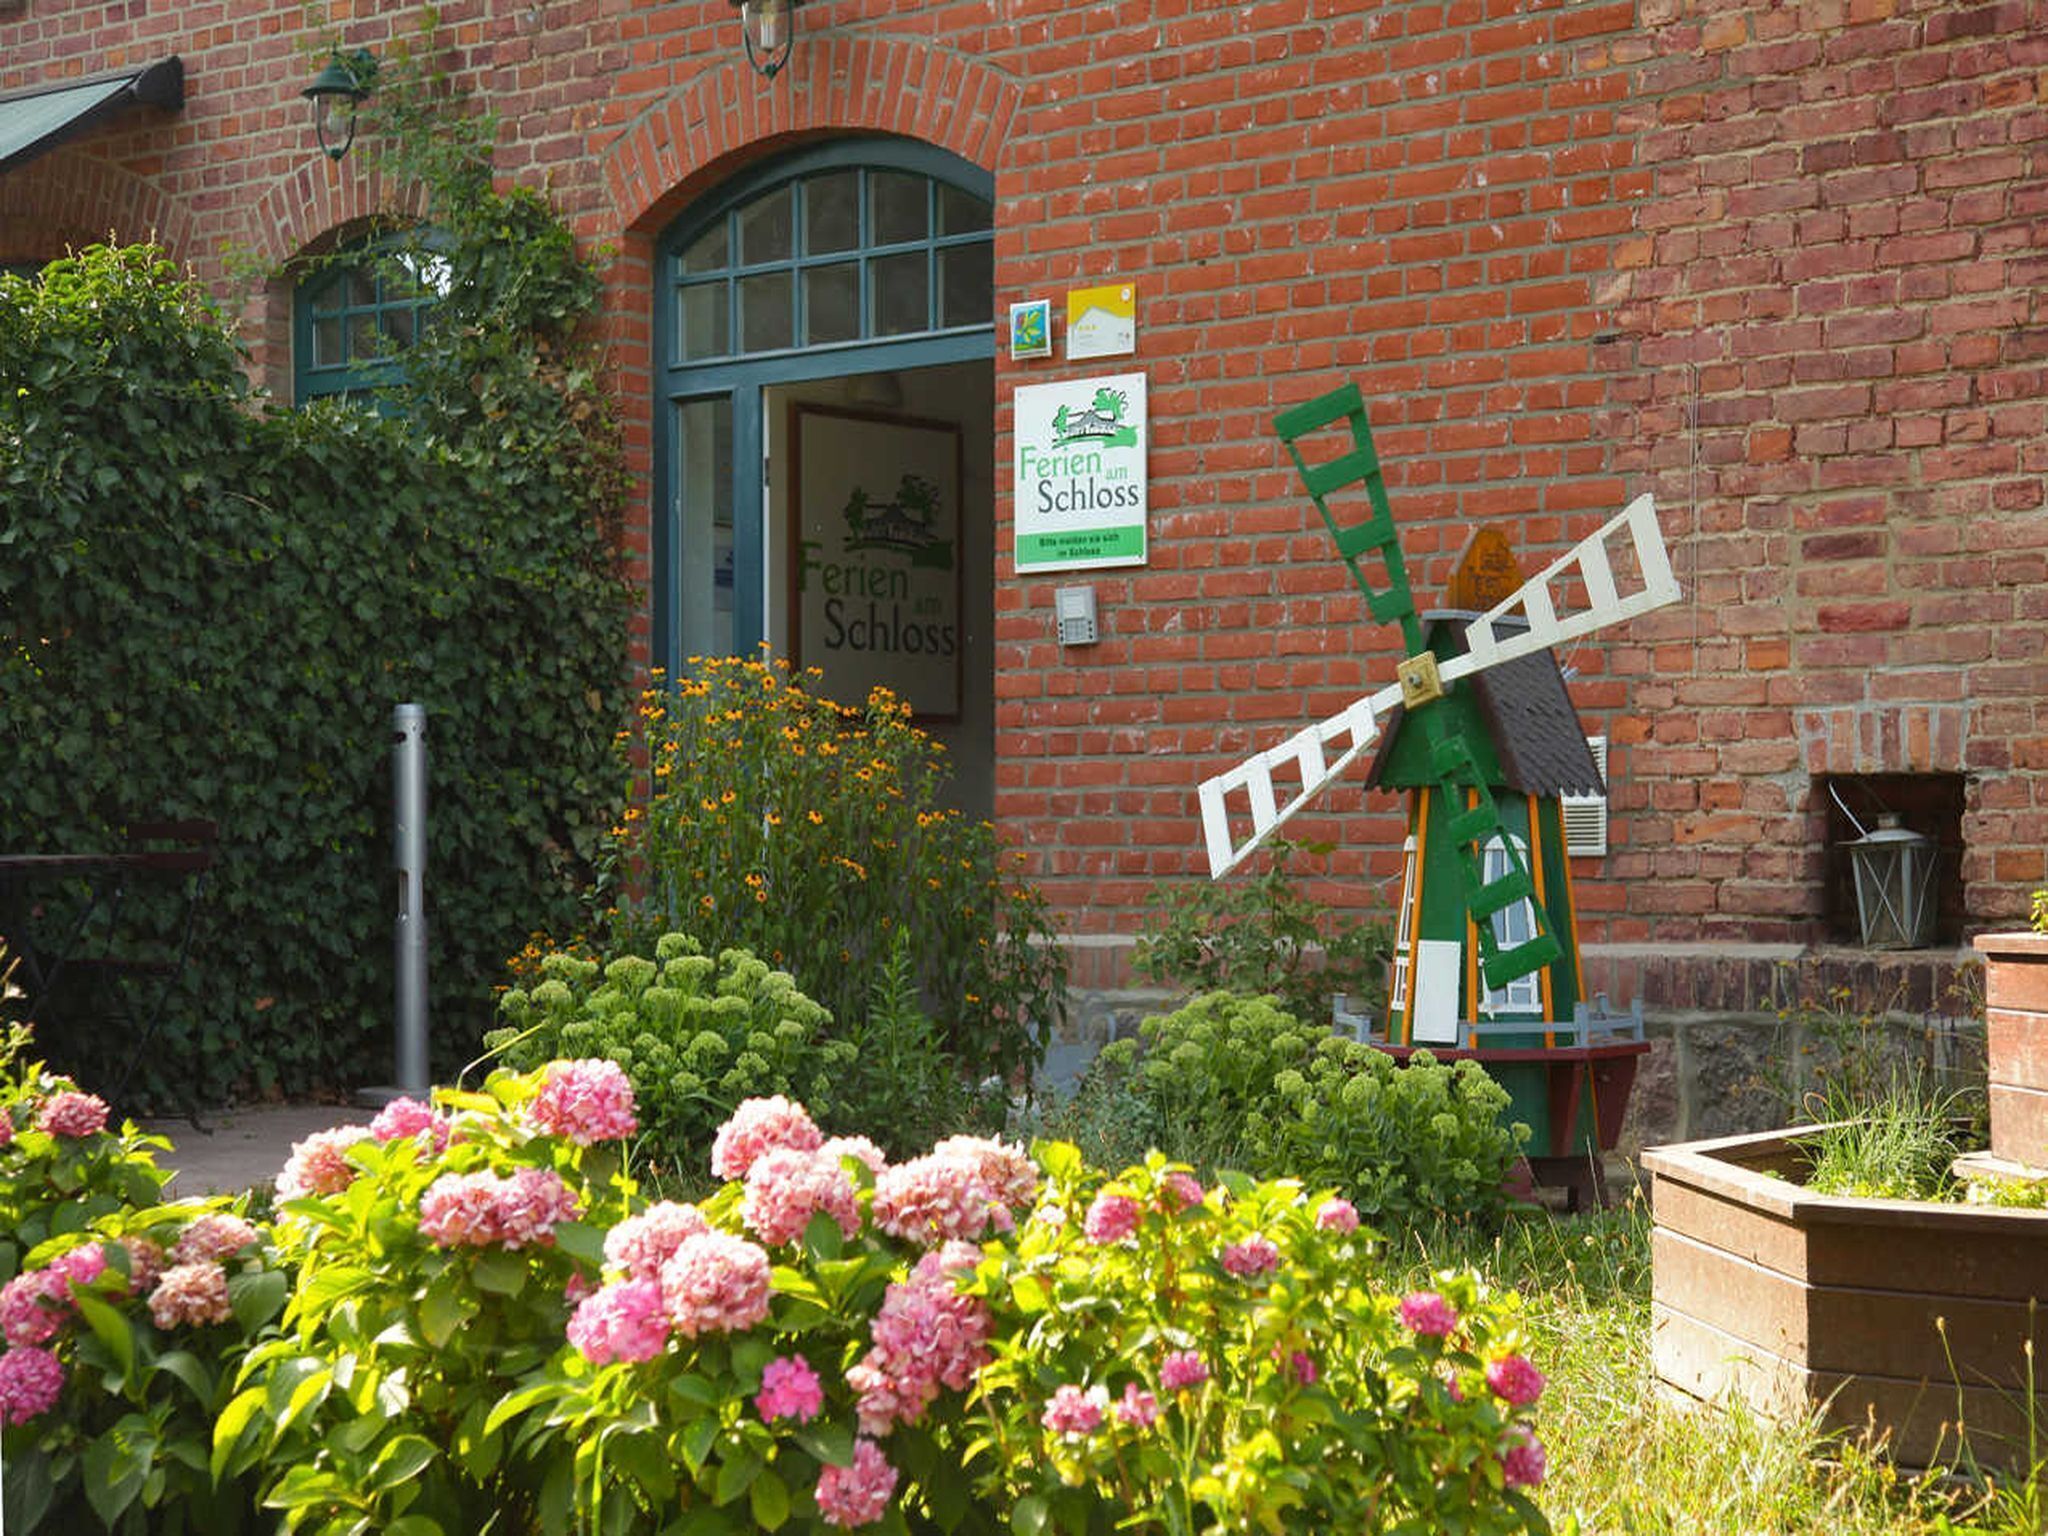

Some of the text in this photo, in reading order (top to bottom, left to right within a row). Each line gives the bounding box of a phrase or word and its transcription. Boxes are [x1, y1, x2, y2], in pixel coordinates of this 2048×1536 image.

[1020, 445, 1128, 480] Ferien am
[1038, 477, 1139, 514] Schloss
[798, 541, 909, 600] Ferien
[824, 598, 955, 656] Schloss
